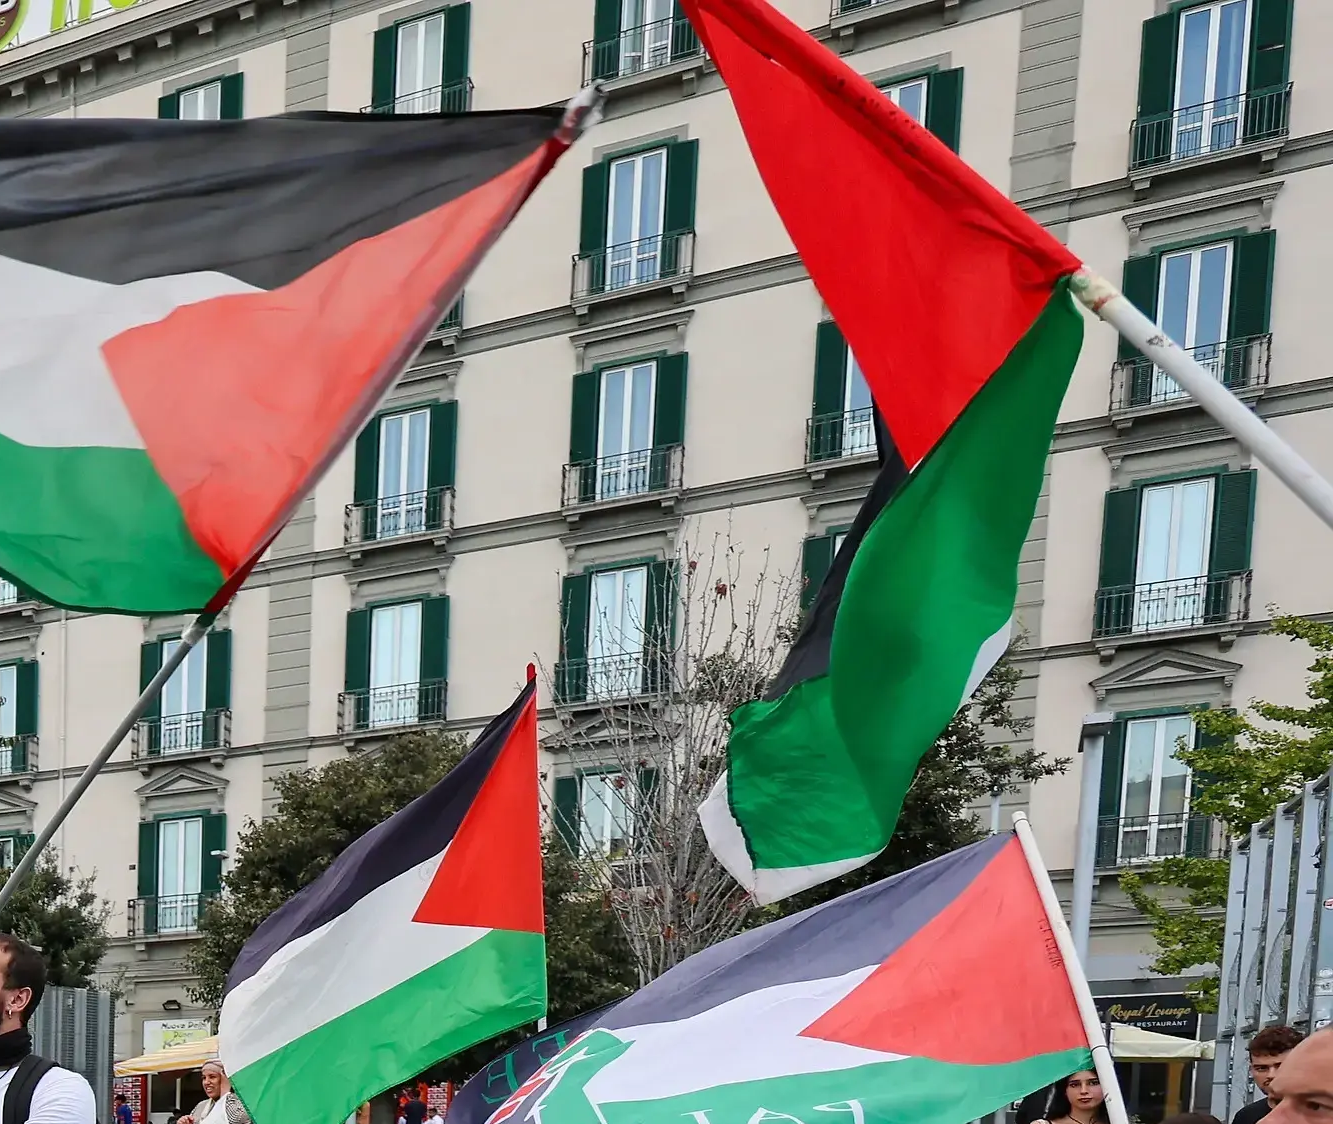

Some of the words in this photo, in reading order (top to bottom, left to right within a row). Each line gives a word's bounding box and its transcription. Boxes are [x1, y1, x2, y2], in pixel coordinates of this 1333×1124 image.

[1108, 1003, 1145, 1021] Royal
[1144, 1002, 1192, 1019] Lounge
[1136, 1020, 1187, 1028] RESTAURANT
